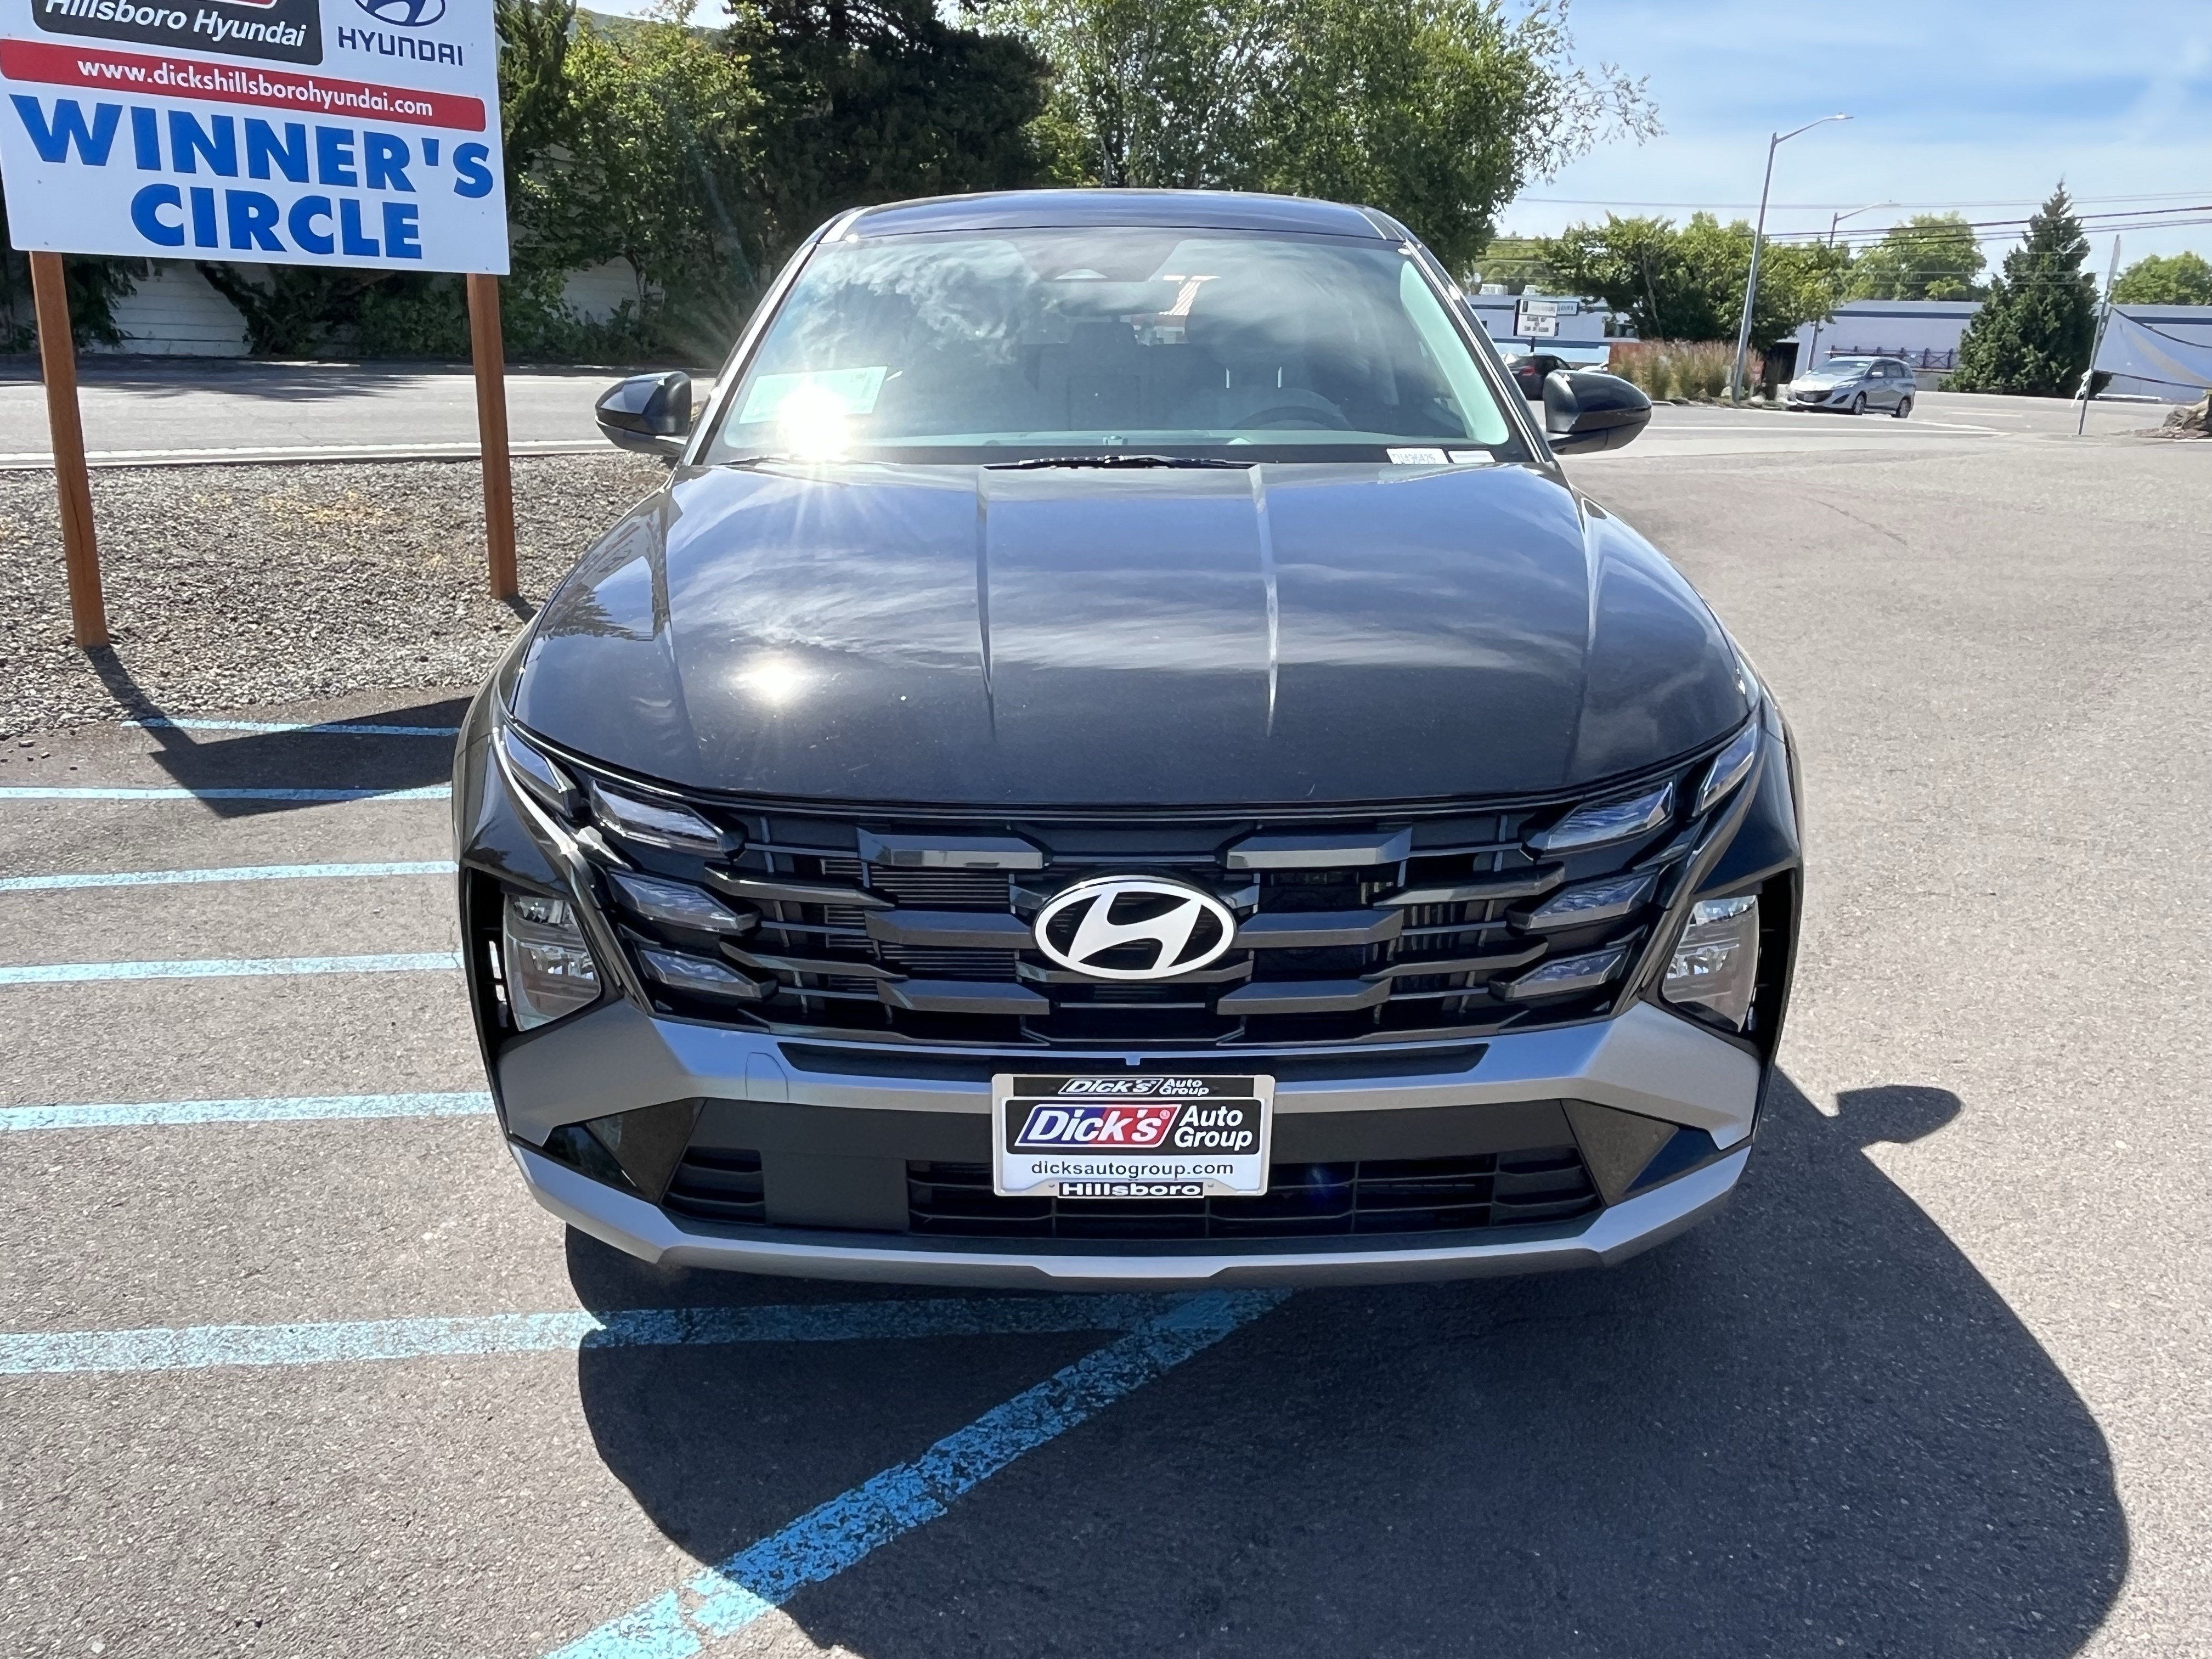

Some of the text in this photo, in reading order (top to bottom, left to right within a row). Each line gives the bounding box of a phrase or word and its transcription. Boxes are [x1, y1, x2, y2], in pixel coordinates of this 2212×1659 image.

[46, 0, 307, 47] Hillsboro Hyundai
[337, 26, 464, 66] HYUNDAI
[77, 58, 433, 117] www.dickshillsborohyundai.com
[8, 94, 494, 199] WINNER'S
[131, 183, 423, 259] CIRCLE
[1159, 1085, 1209, 1096] Group
[1165, 1078, 1203, 1087] Auto
[1179, 1105, 1243, 1127] Auto
[1174, 1127, 1253, 1151] Group
[1031, 1160, 1233, 1178] dicksautogroup.com
[1062, 1182, 1201, 1197] Hillsboro
